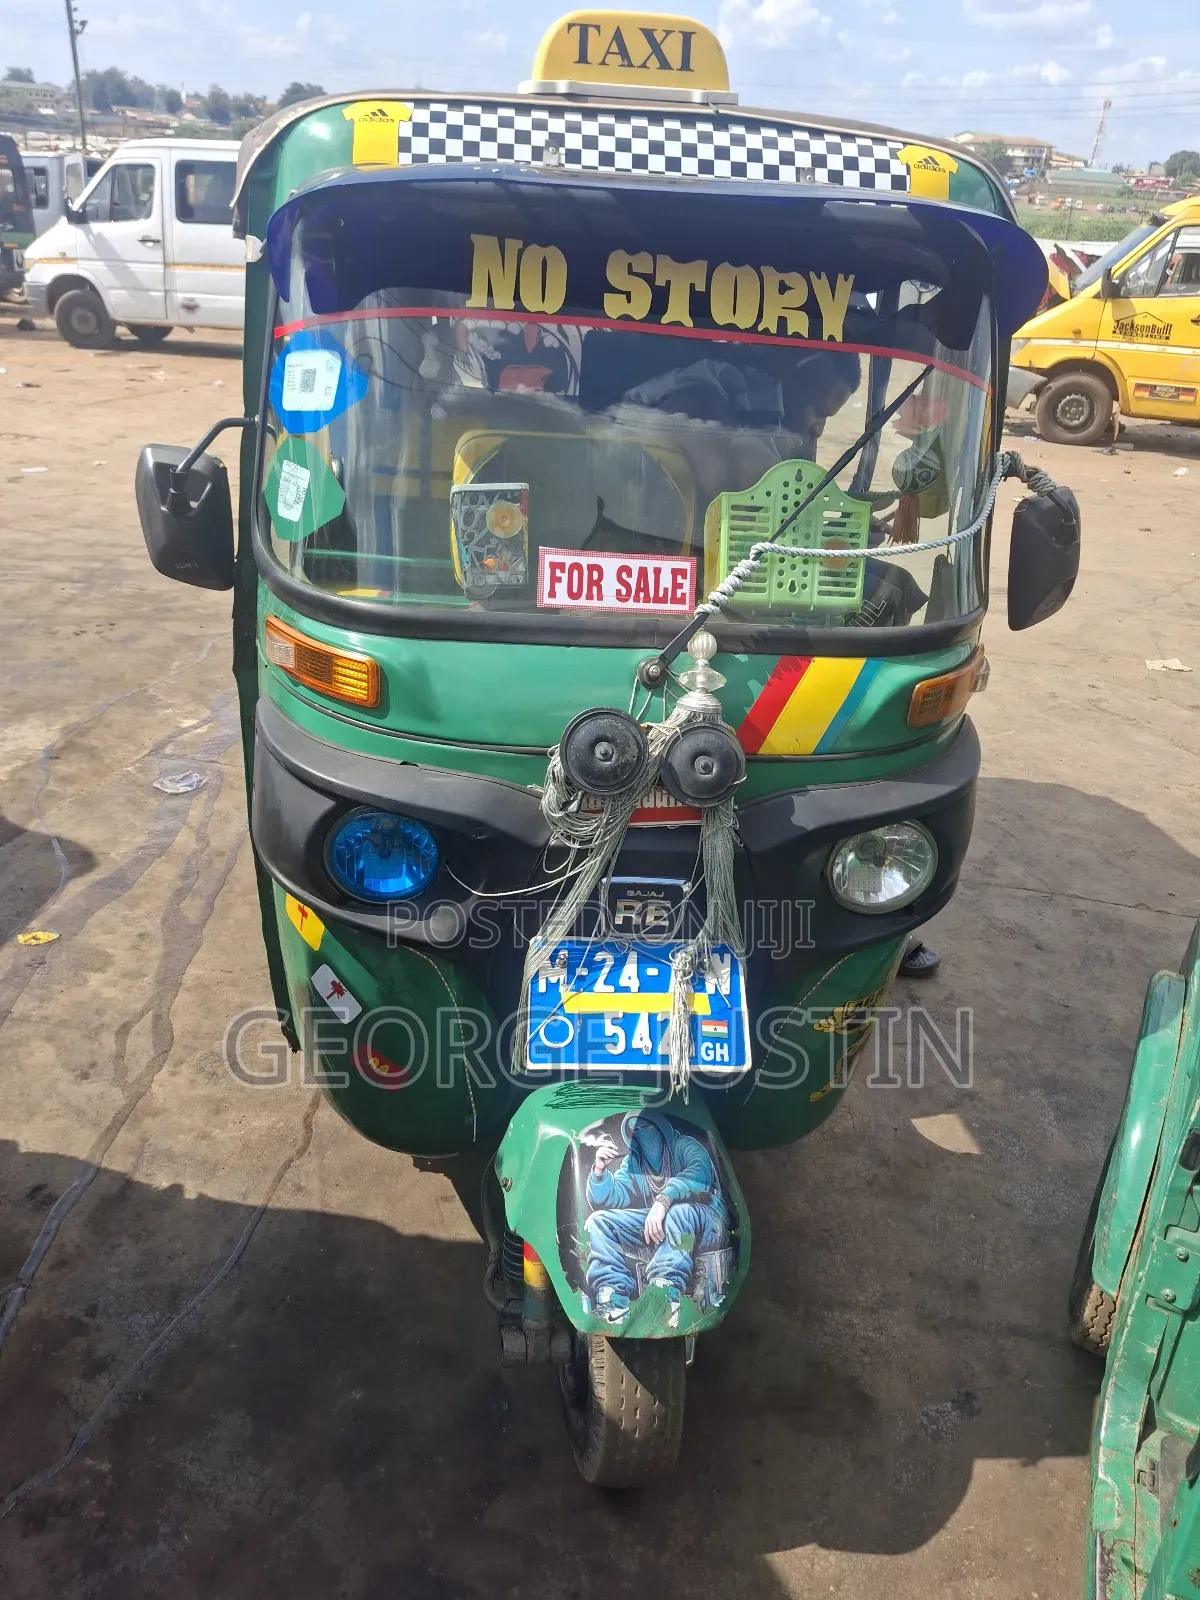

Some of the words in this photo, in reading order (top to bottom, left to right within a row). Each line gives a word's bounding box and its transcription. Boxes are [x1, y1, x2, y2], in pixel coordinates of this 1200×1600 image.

[566, 22, 697, 73] TAXI
[358, 114, 395, 123] adidas
[913, 162, 947, 174] adidas
[465, 233, 568, 315] NO
[603, 248, 855, 342] STORY
[547, 561, 604, 602] FOR
[615, 564, 688, 605] SALE
[626, 889, 665, 898] BAJAJ
[614, 900, 672, 926] RE
[700, 1042, 729, 1062] GH
